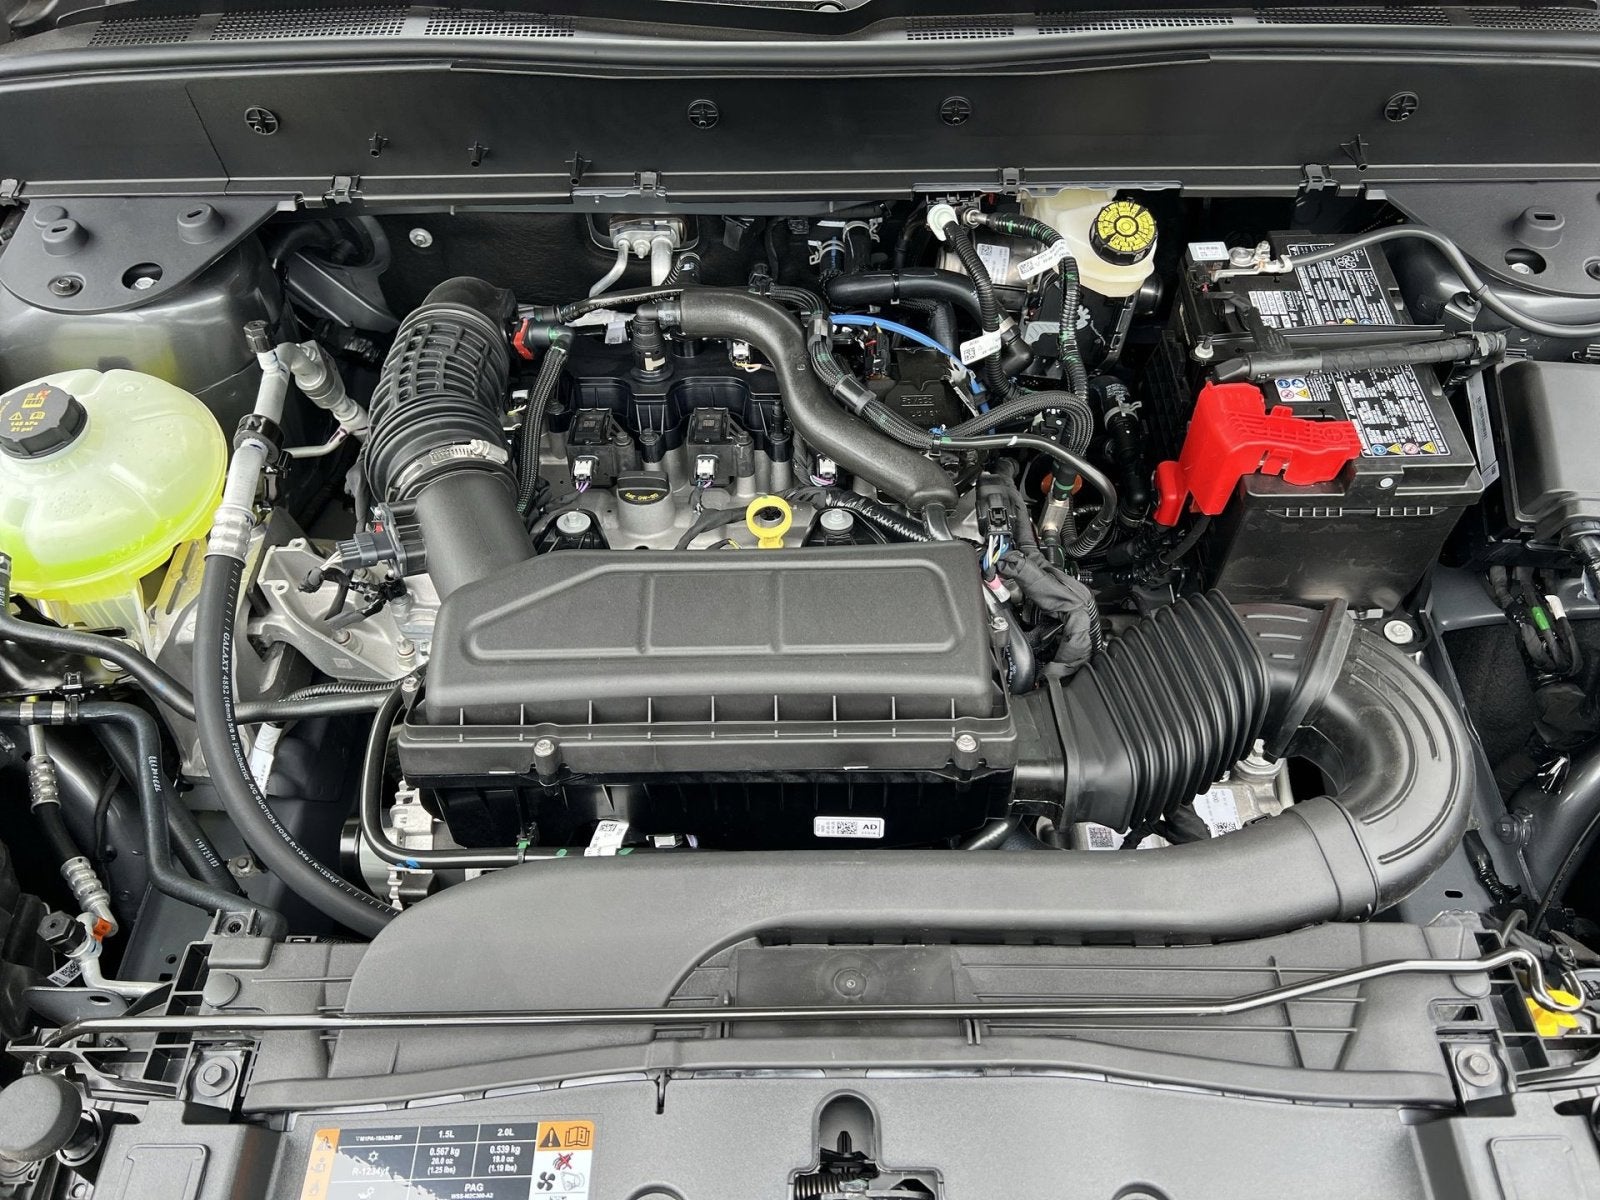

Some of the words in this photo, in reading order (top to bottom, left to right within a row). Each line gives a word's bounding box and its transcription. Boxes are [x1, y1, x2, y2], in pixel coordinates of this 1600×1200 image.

[222, 632, 231, 674] GALAXY
[232, 741, 251, 781] Flexbarrier
[255, 795, 278, 825] SUCTION
[274, 824, 291, 842] HOSE
[438, 1130, 455, 1138] 1.5L
[497, 1128, 515, 1137] 2.0L
[450, 1147, 460, 1158] kg
[489, 1144, 510, 1154] 0.539
[510, 1144, 521, 1155] kg
[351, 1166, 390, 1177] R-1234yf
[427, 1166, 443, 1176] (1.25
[443, 1165, 457, 1175] lbs)
[488, 1163, 504, 1174] (1.19
[504, 1163, 518, 1173] lbs)
[463, 1182, 485, 1192] PAG
